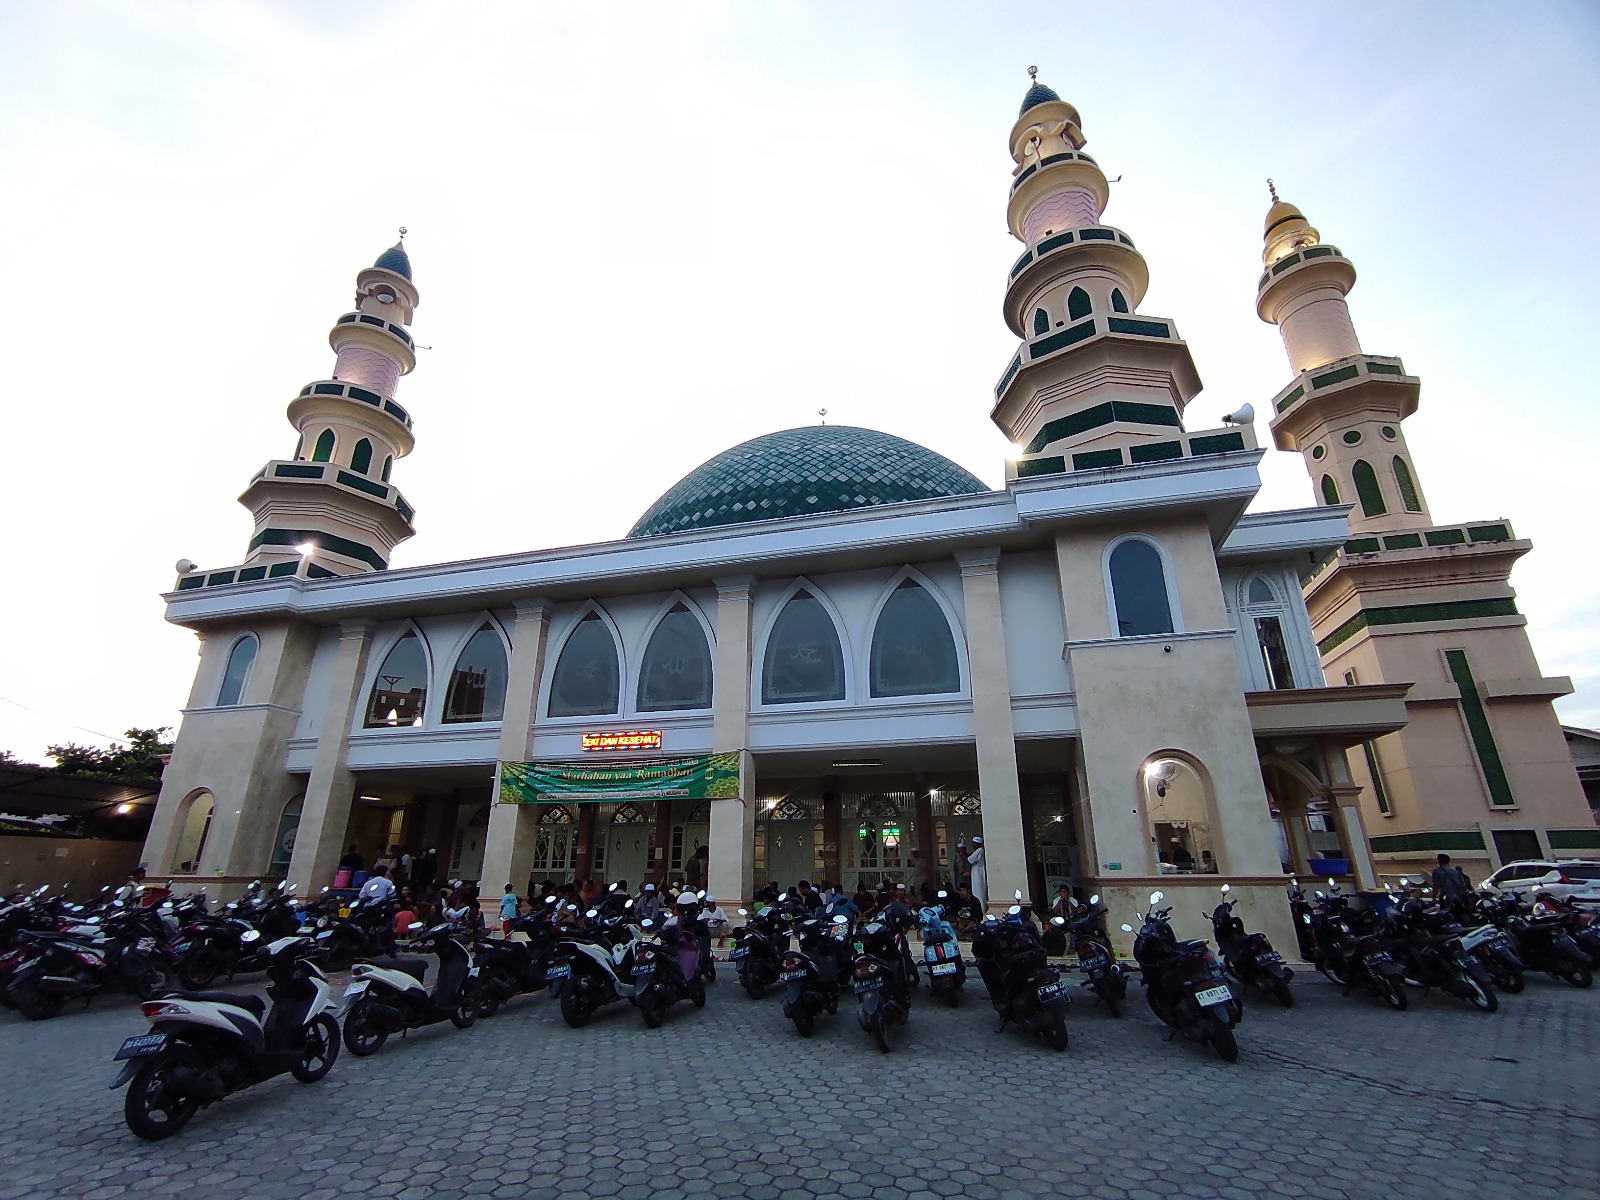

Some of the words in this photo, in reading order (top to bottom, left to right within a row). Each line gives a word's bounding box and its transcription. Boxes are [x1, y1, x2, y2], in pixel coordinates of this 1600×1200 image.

[600, 737, 618, 746] DAN
[560, 771, 612, 781] Marhaban
[614, 772, 632, 782] yaa
[635, 767, 694, 780] Ramadhan
